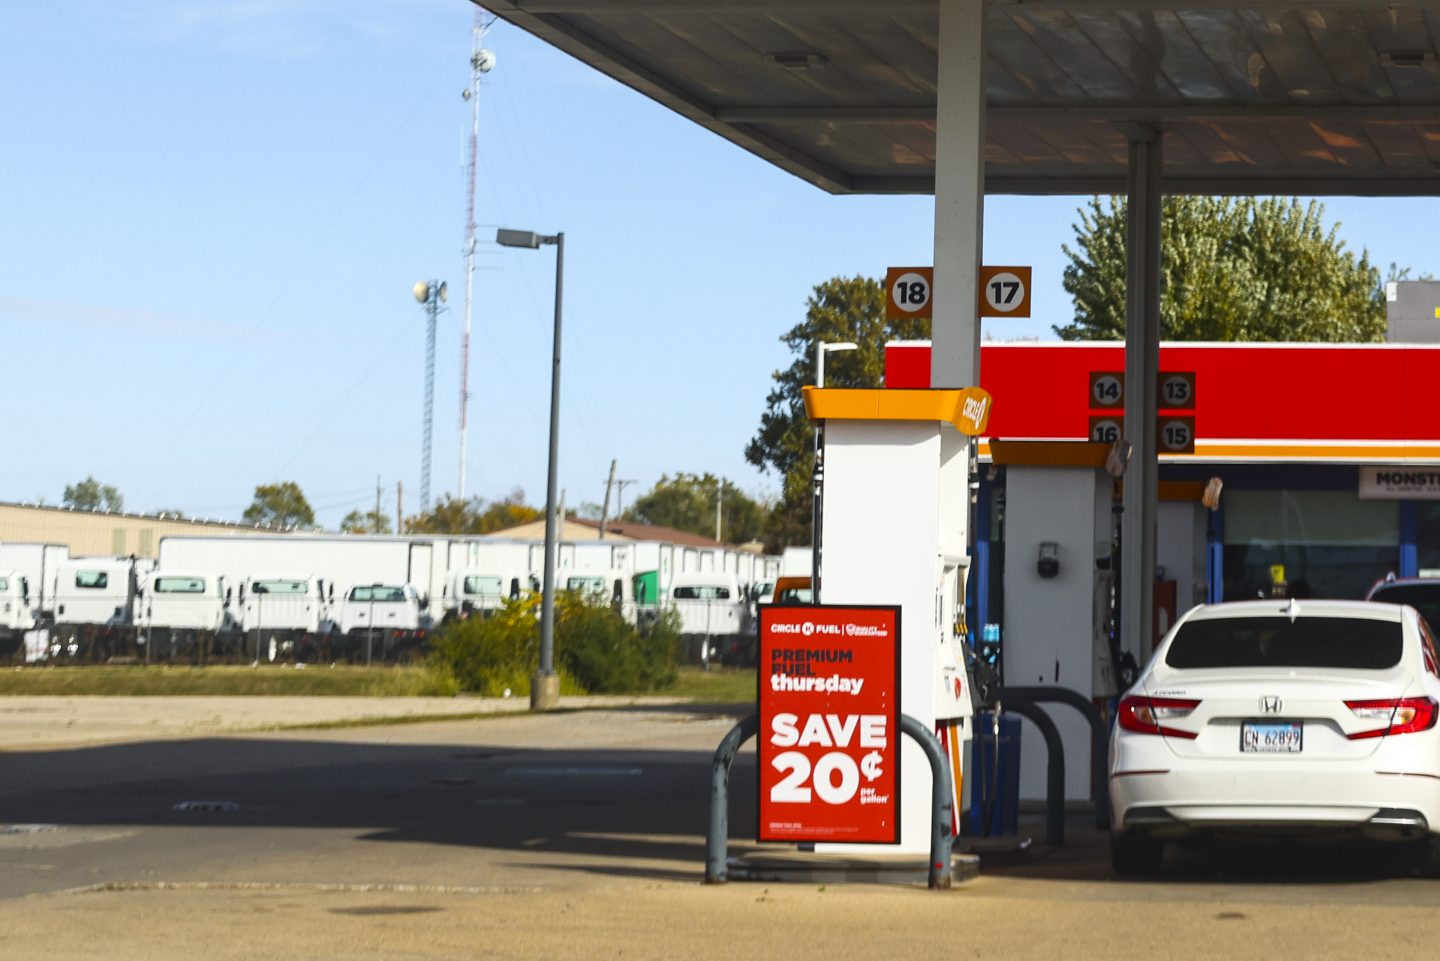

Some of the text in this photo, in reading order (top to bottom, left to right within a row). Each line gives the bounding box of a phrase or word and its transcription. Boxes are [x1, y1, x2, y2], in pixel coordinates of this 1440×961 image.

[897, 281, 926, 305] 18
[991, 281, 1020, 304] 17
[1096, 382, 1118, 400] 14
[1165, 382, 1187, 400] 13
[1095, 426, 1118, 442] 16
[1165, 427, 1187, 445] 15
[770, 623, 801, 634] CIRCLE
[816, 625, 841, 634] FUEL
[771, 649, 853, 663] PREMIUM
[771, 663, 816, 676] FUEL
[770, 673, 864, 695] thursday
[770, 712, 887, 748] SAVE
